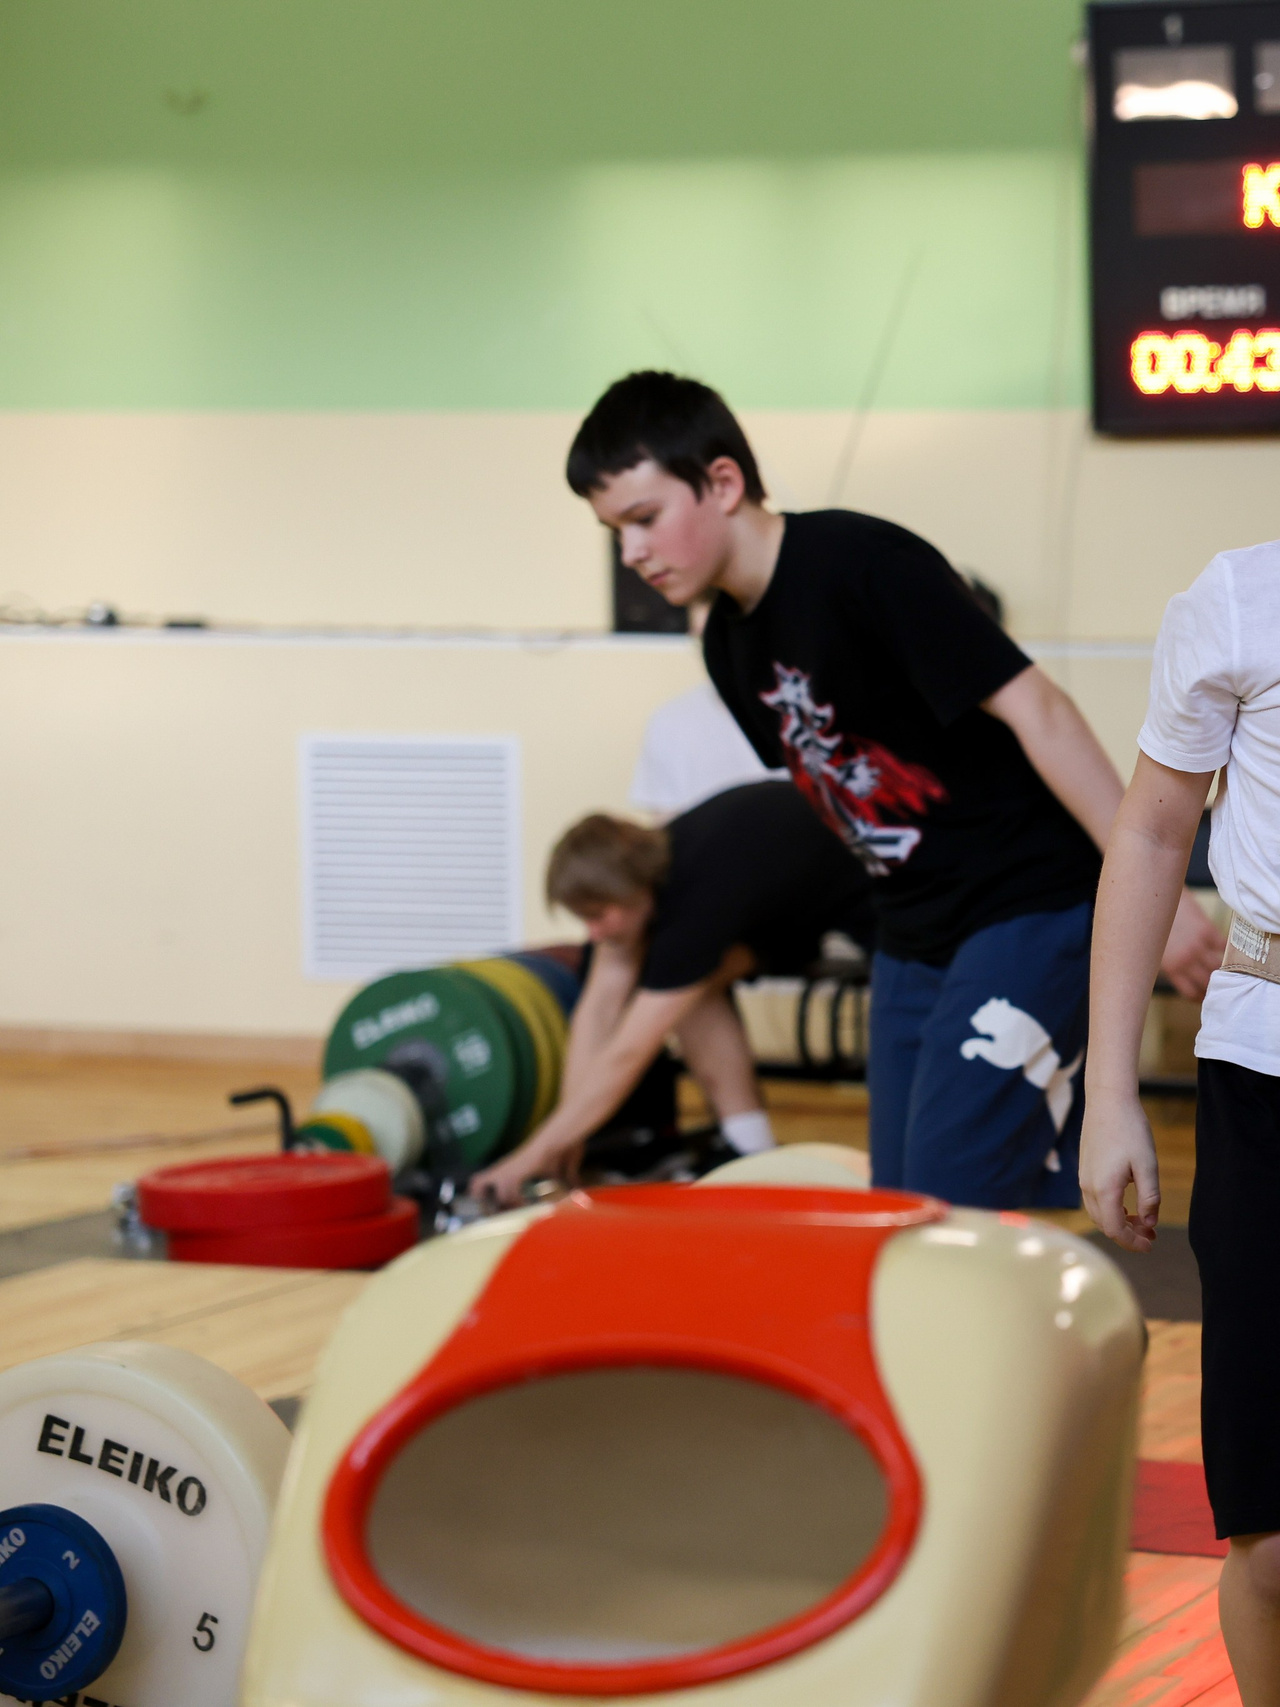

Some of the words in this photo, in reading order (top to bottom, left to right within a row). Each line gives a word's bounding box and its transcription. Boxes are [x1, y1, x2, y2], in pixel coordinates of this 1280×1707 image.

[37, 1414, 207, 1516] ELEIKO
[62, 1550, 80, 1570] 2
[39, 1609, 101, 1680] ELEIKO
[192, 1612, 219, 1652] 5
